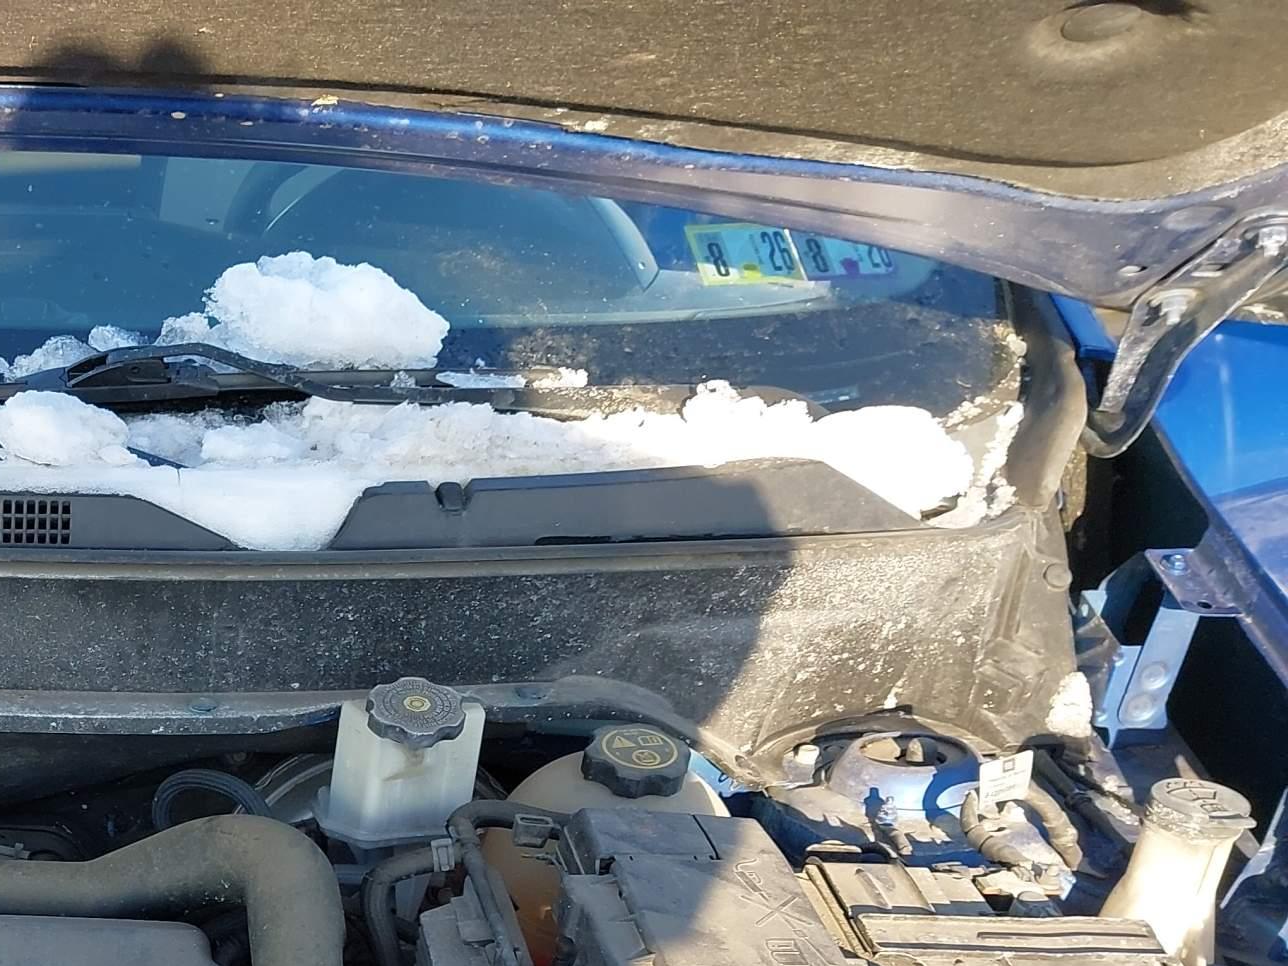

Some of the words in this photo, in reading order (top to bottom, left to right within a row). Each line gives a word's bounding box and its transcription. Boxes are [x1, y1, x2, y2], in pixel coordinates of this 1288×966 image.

[707, 242, 730, 277] 8
[760, 231, 795, 271] 26
[806, 238, 829, 273] 8
